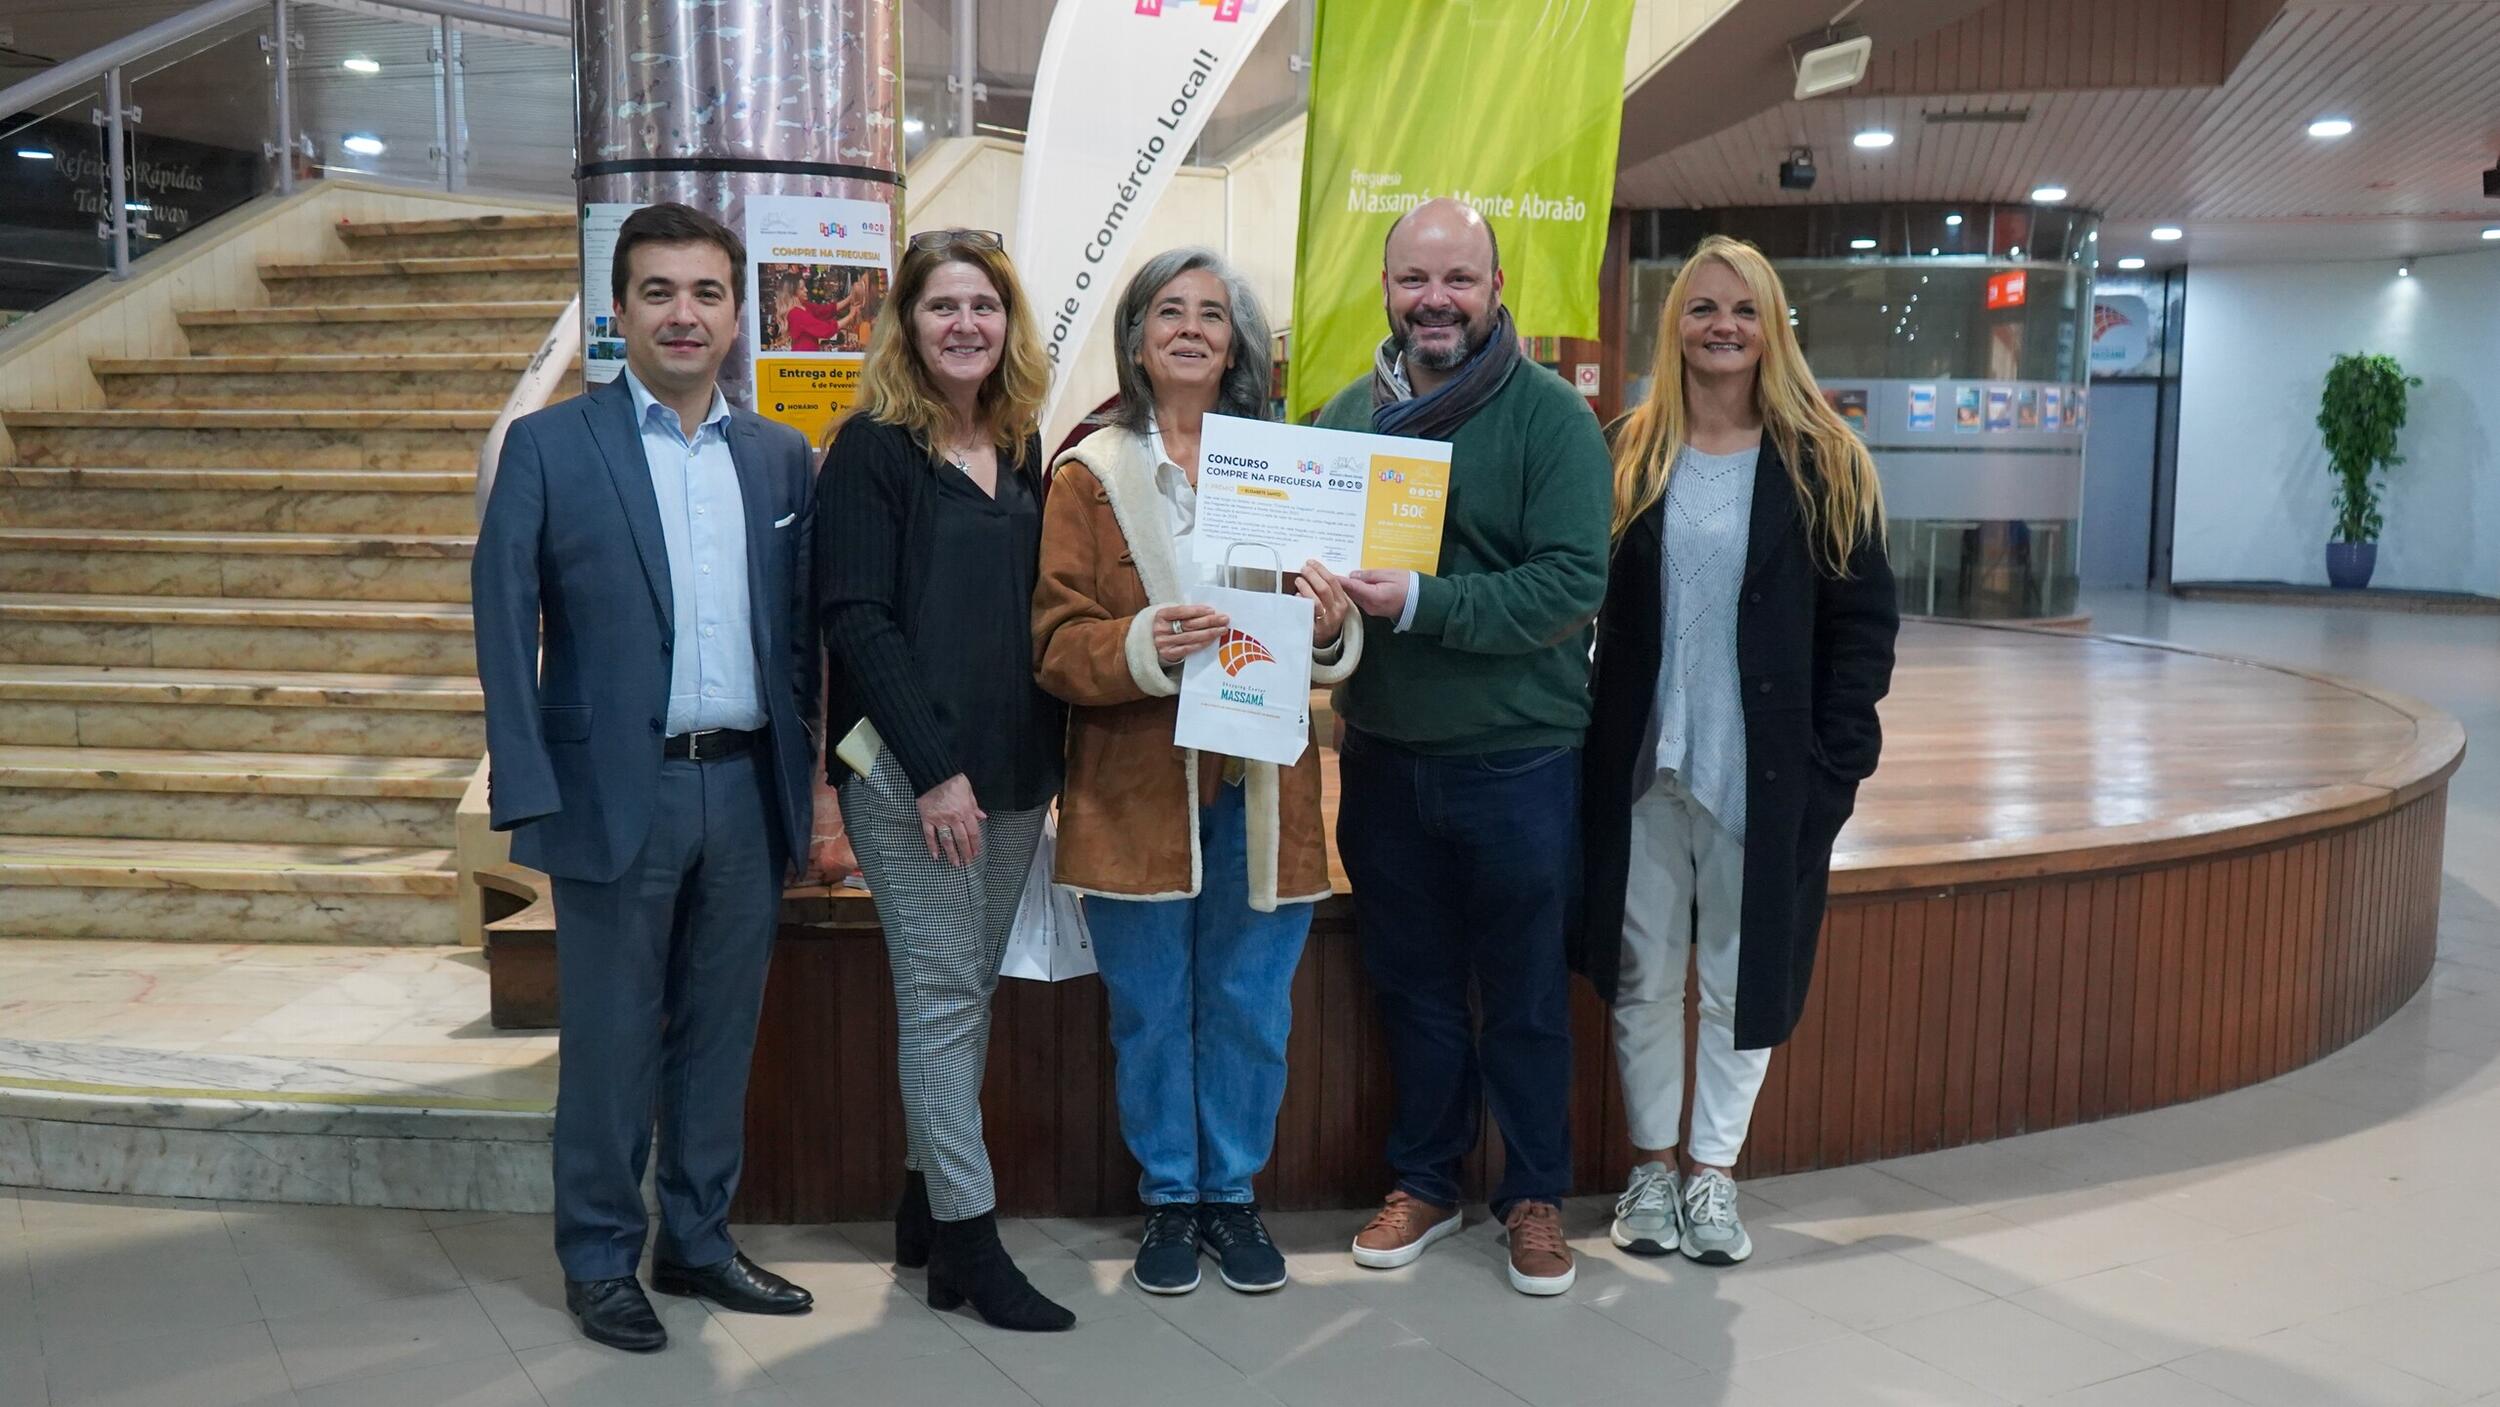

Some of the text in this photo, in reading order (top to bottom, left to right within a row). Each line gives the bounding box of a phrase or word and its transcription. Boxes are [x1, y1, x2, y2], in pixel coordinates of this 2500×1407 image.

[137, 161, 203, 194] Rápidas
[1046, 48, 1219, 364] poie o Comércio Local!
[1518, 192, 1586, 222] Abraão
[772, 247, 817, 257] COMPRE
[819, 248, 834, 258] NA
[779, 368, 826, 380] Entrega
[829, 368, 843, 378] de
[1207, 453, 1269, 470] CONCURSO
[1206, 466, 1249, 480] COMPRE
[1251, 472, 1266, 482] NA
[1267, 474, 1322, 489] FREGUESIA
[1391, 502, 1427, 519] 150€
[1221, 688, 1264, 706] MASSAMÁ
